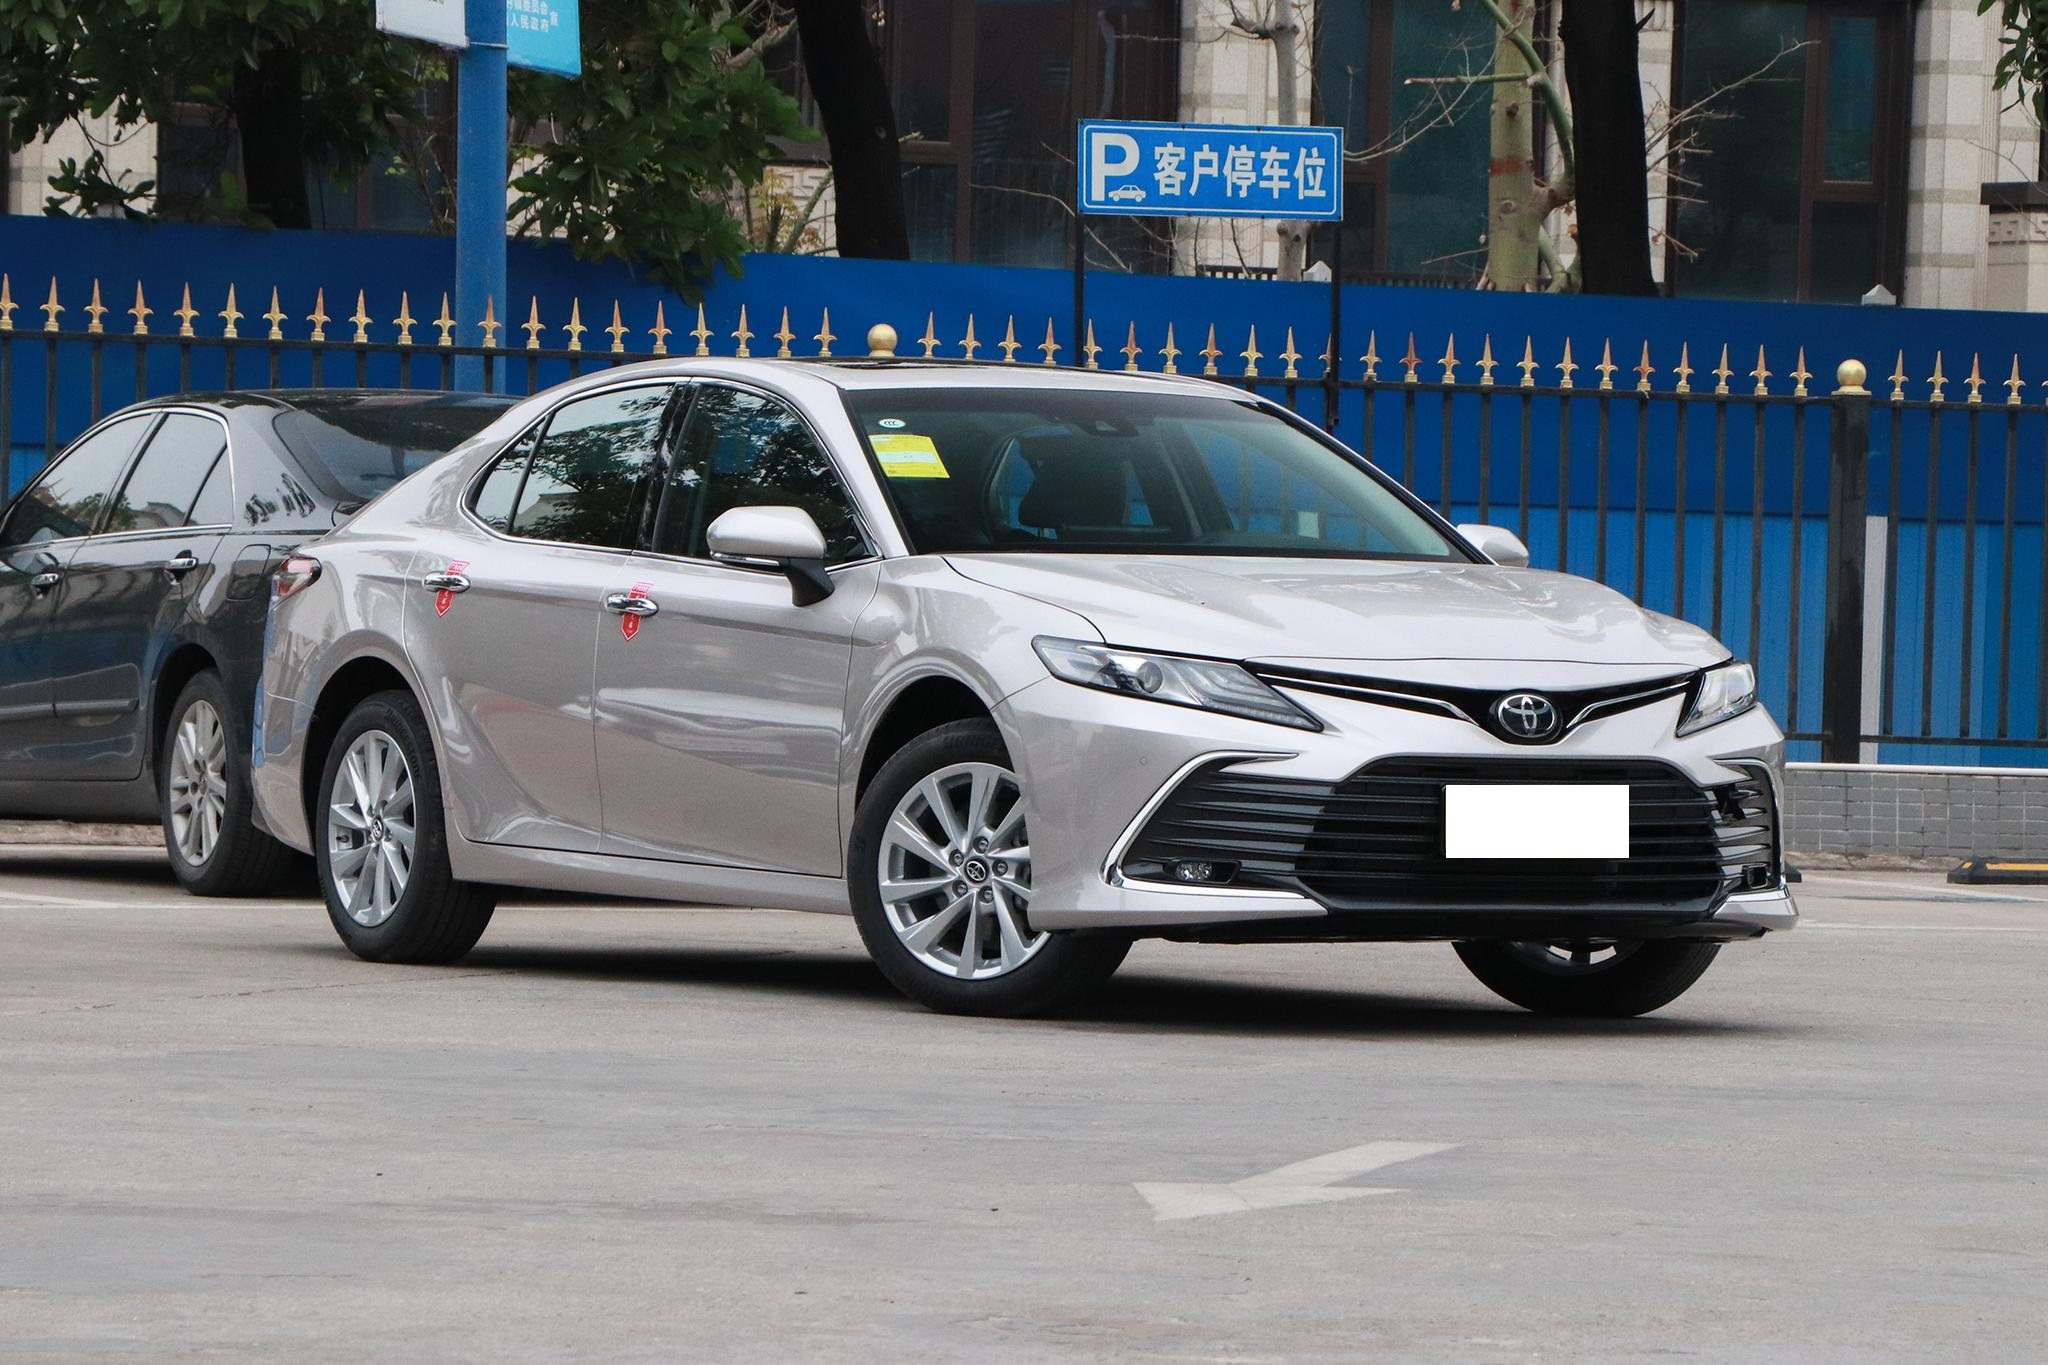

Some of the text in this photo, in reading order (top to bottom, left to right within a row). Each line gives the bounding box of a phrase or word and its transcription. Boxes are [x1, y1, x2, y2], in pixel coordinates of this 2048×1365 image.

[1091, 132, 1140, 201] P
[1153, 142, 1327, 200] 客户停车位
